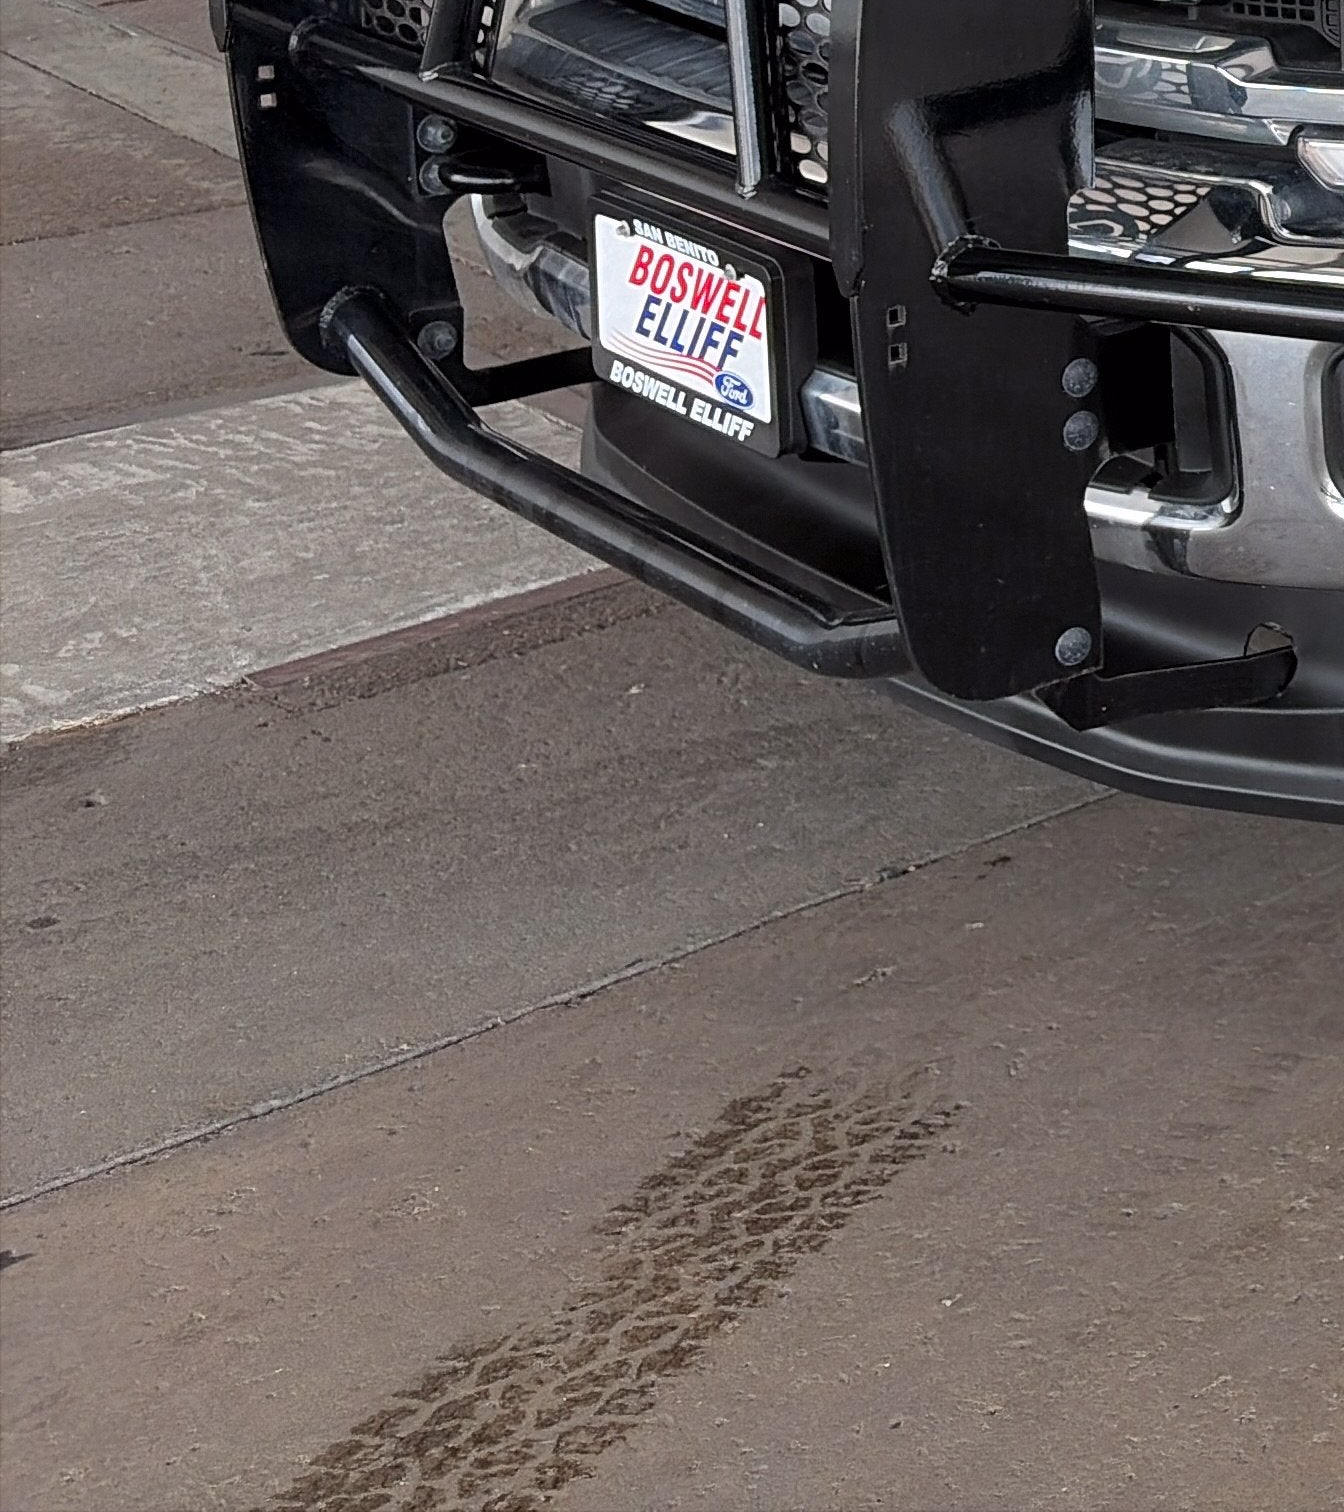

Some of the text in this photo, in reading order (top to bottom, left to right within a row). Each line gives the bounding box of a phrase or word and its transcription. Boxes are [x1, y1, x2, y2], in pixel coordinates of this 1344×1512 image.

[633, 218, 719, 266] SAN BENITO
[629, 244, 767, 340] BOSWELL
[635, 295, 744, 368] ELLIFF
[609, 359, 755, 442] BOSWELL ELLIFF
[719, 378, 748, 405] Ford
